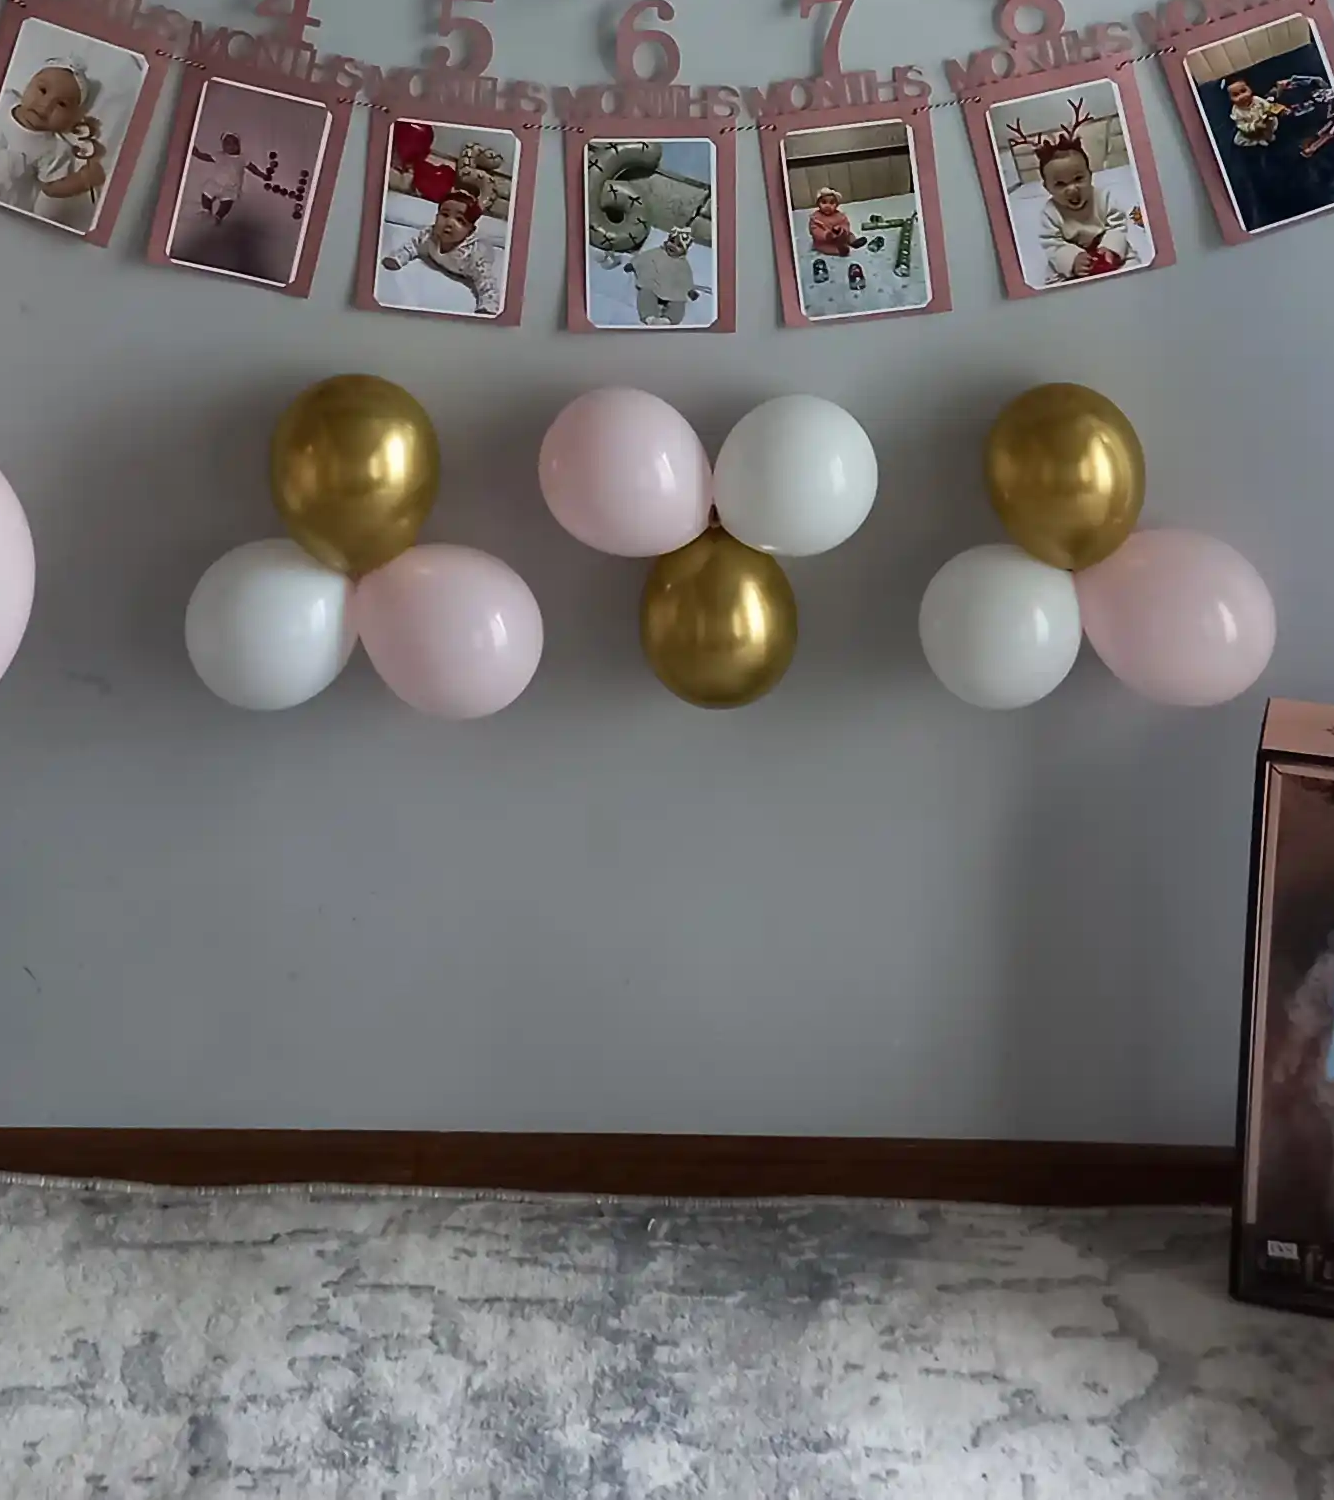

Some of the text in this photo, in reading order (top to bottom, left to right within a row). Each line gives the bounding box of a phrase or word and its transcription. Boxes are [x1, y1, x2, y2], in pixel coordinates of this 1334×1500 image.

[187, 20, 365, 92] MONTHS
[946, 22, 1134, 98] MONTHS
[370, 63, 549, 116] MONTHS
[553, 83, 741, 120] MONTHS
[744, 65, 933, 118] MONTHS
